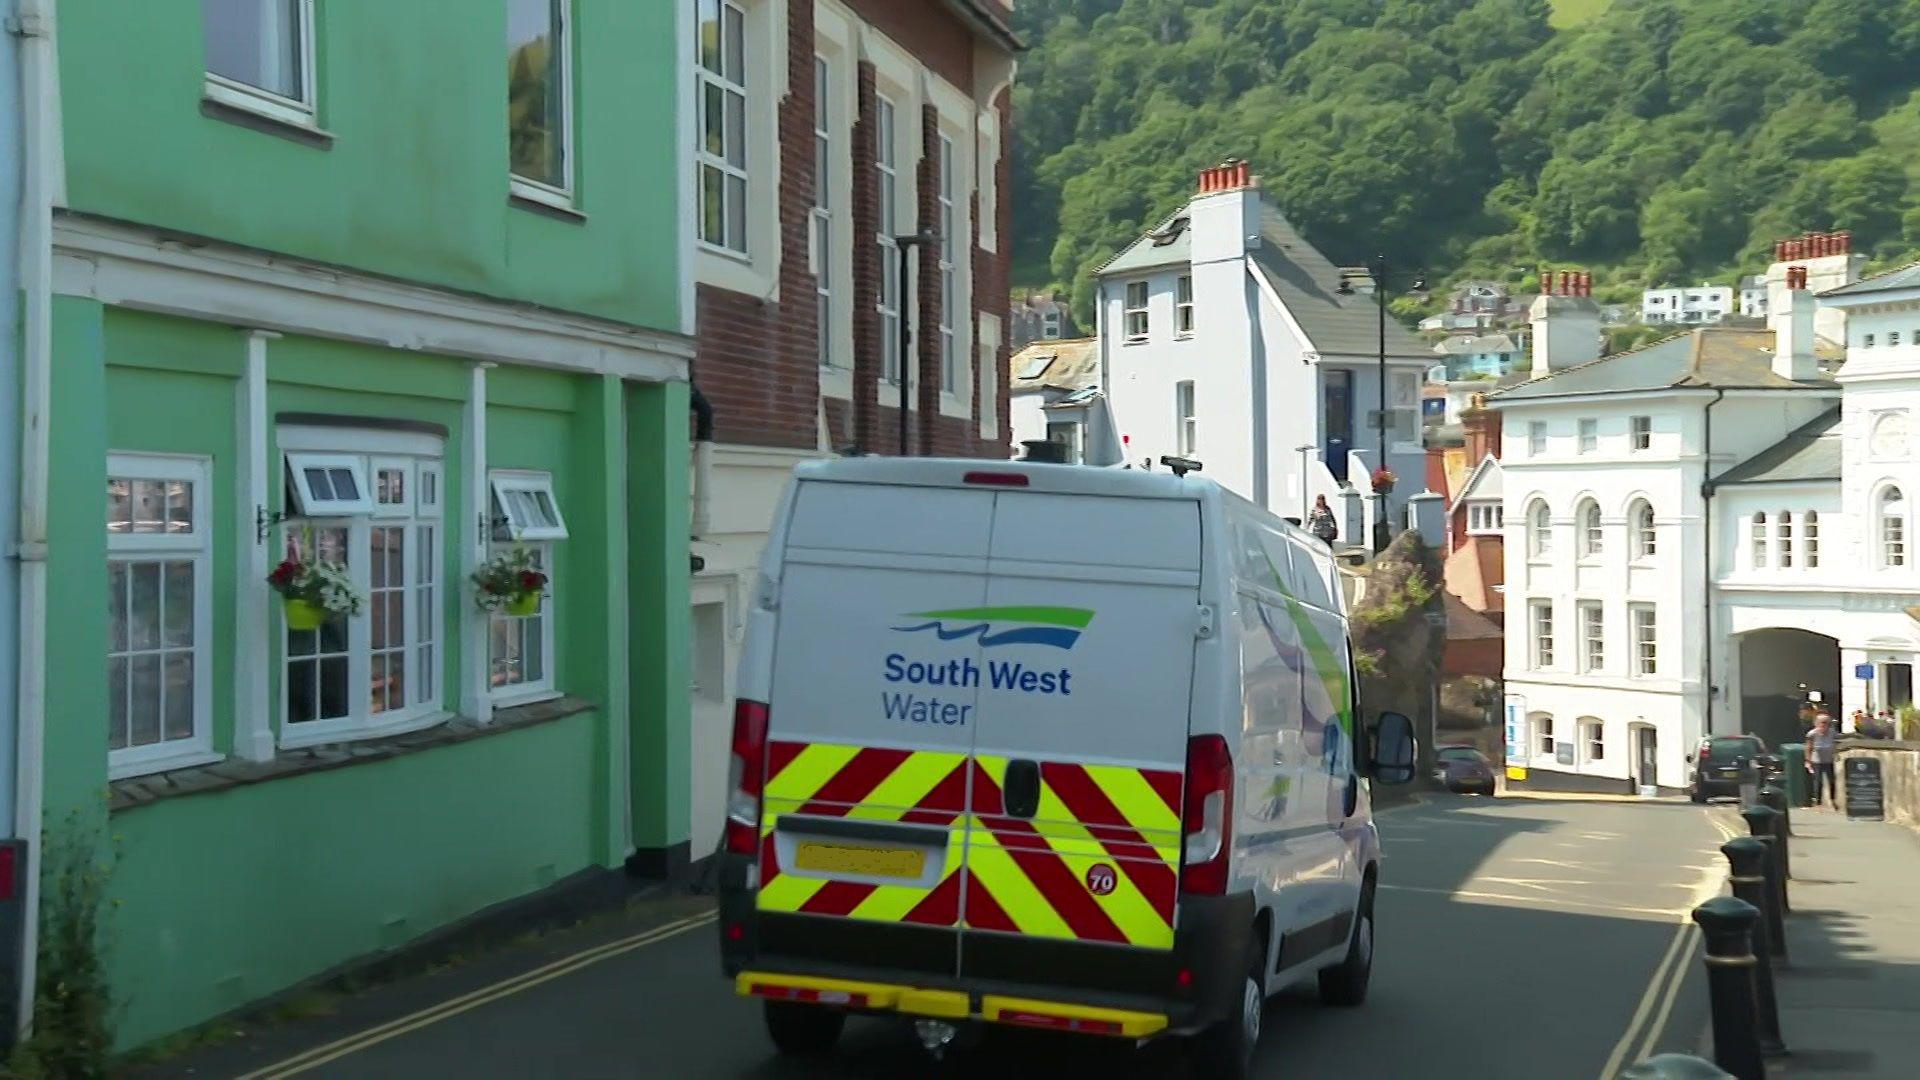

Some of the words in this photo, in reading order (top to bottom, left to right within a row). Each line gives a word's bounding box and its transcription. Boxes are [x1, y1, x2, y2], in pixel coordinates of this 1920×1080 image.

[884, 653, 980, 688] South
[989, 660, 1072, 695] West
[881, 692, 973, 726] Water
[1089, 874, 1114, 890] 70
